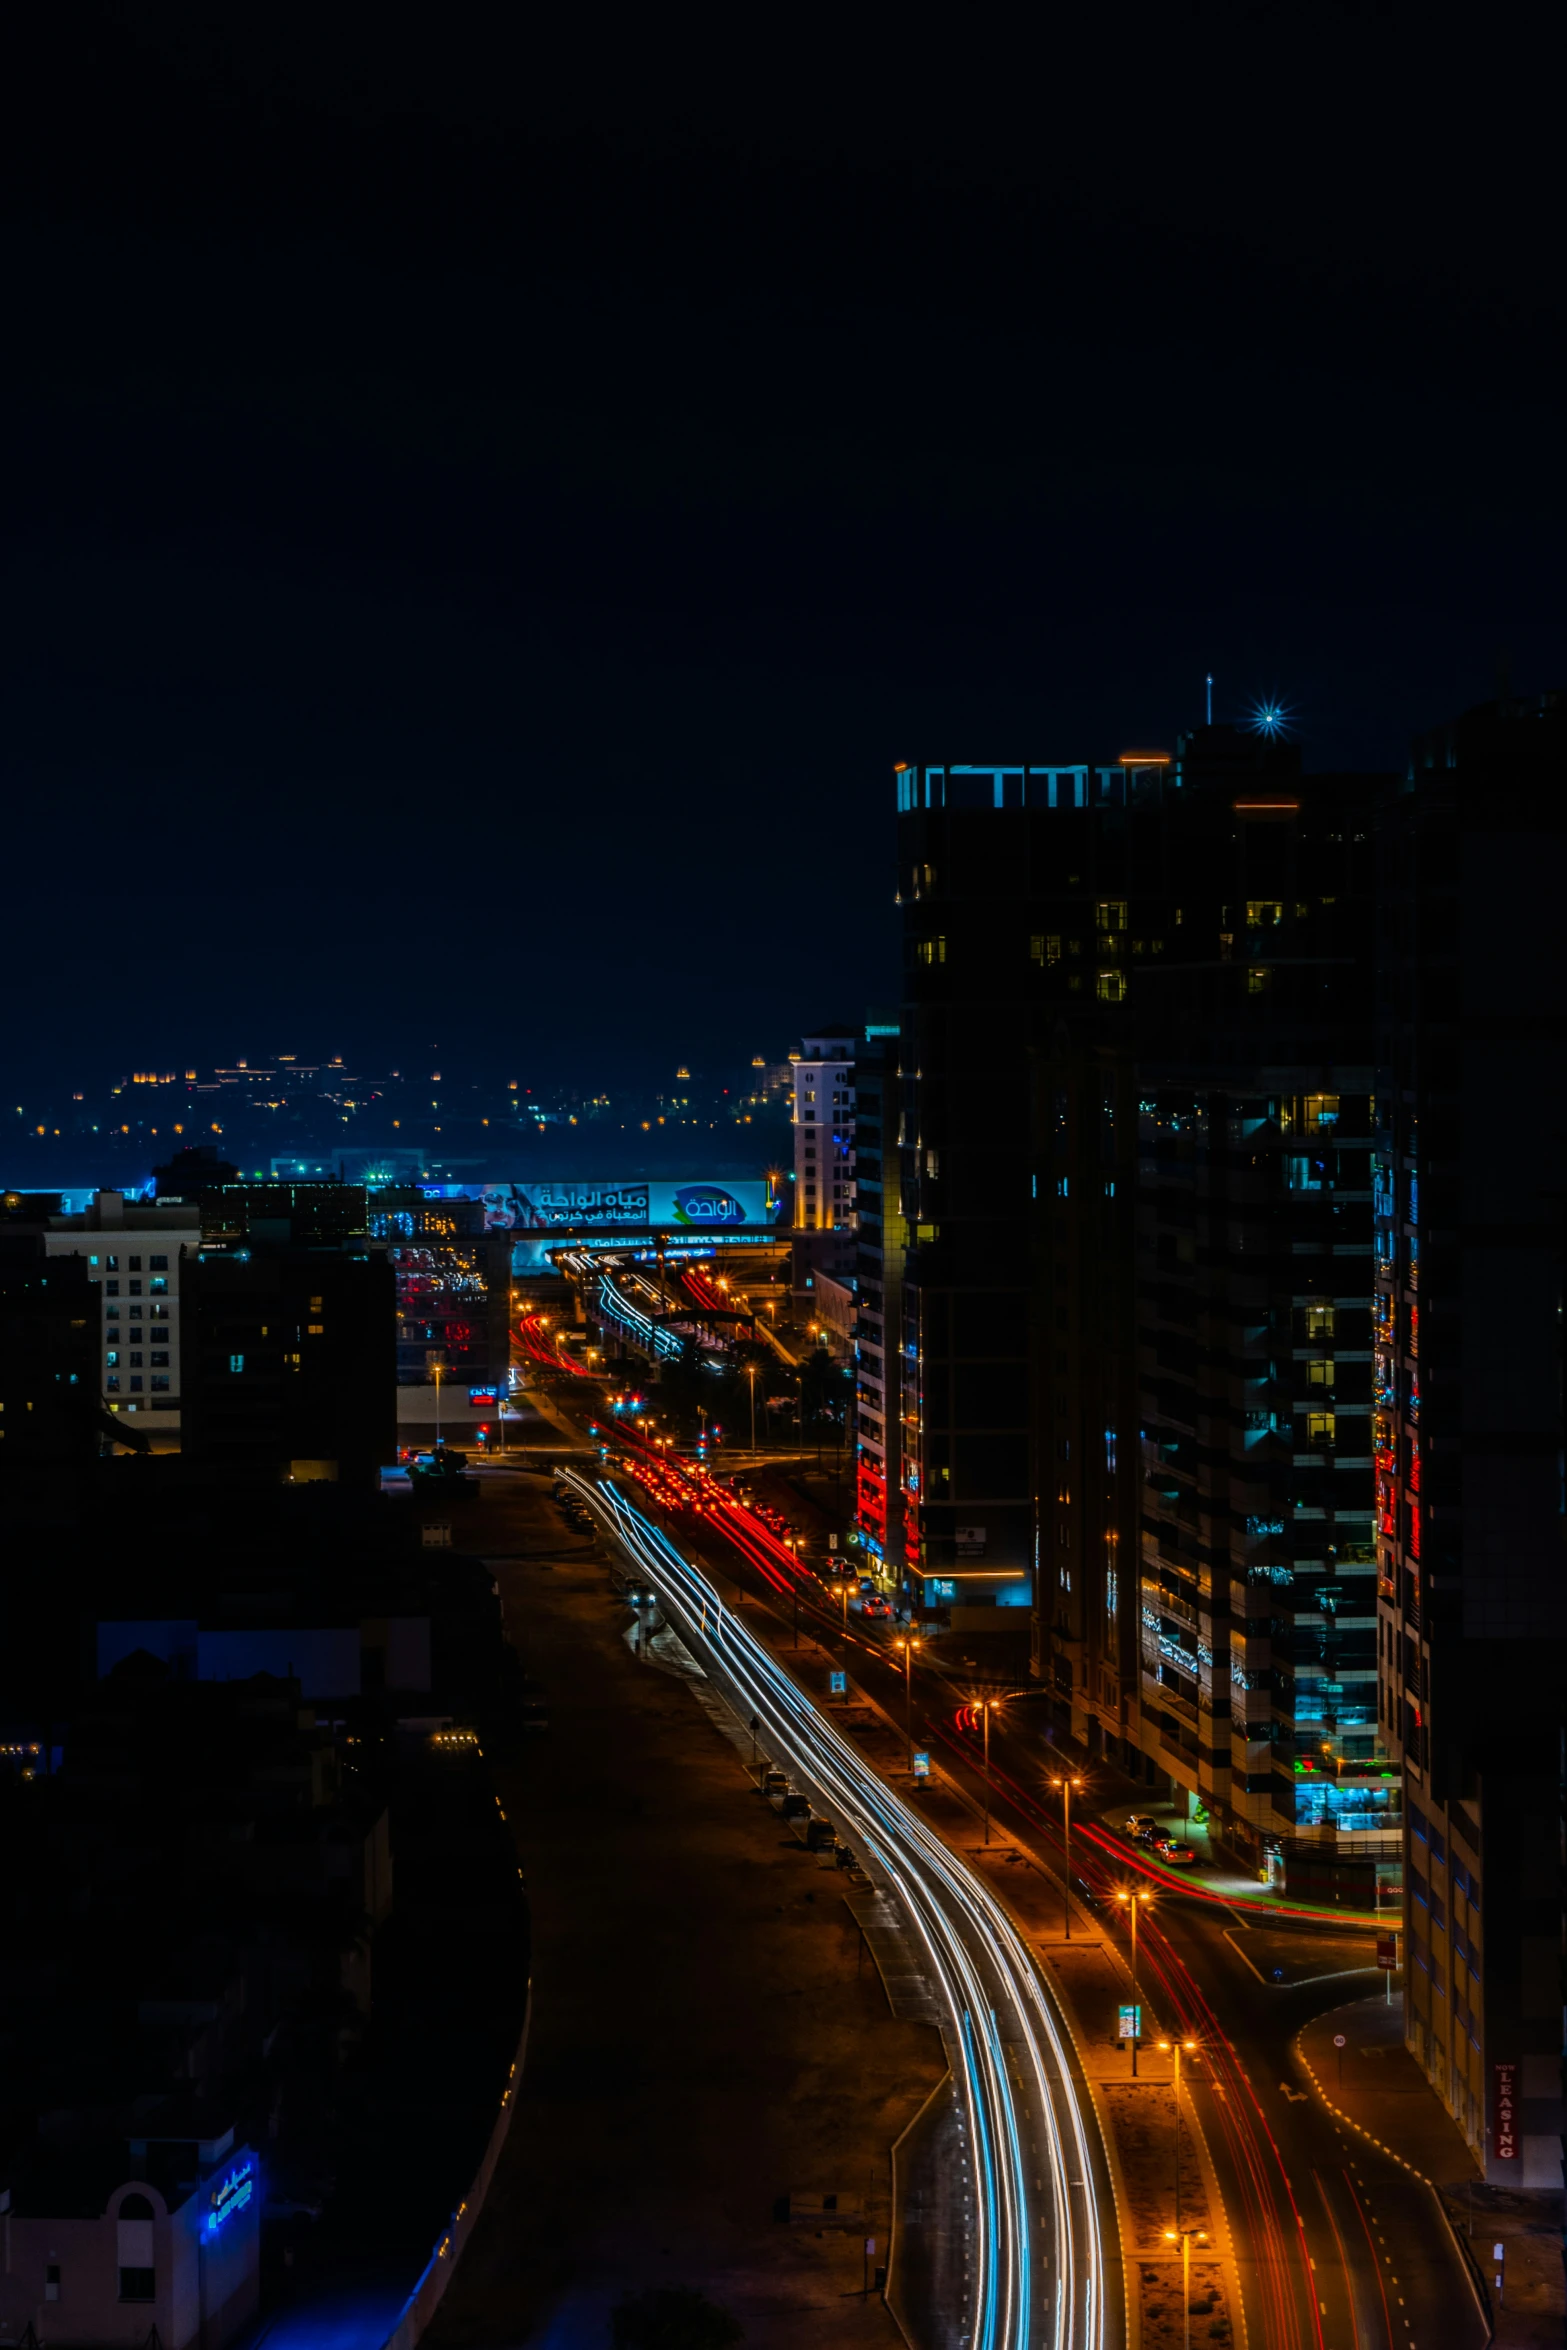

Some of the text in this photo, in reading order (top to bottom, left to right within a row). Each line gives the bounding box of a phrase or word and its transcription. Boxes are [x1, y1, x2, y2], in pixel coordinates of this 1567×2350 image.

[541, 1189, 647, 1210] مياه الواحة
[685, 1198, 737, 1221] الواحة
[548, 1208, 647, 1224] المعبأة في كرتون
[1499, 2072, 1515, 2159] LEASING
